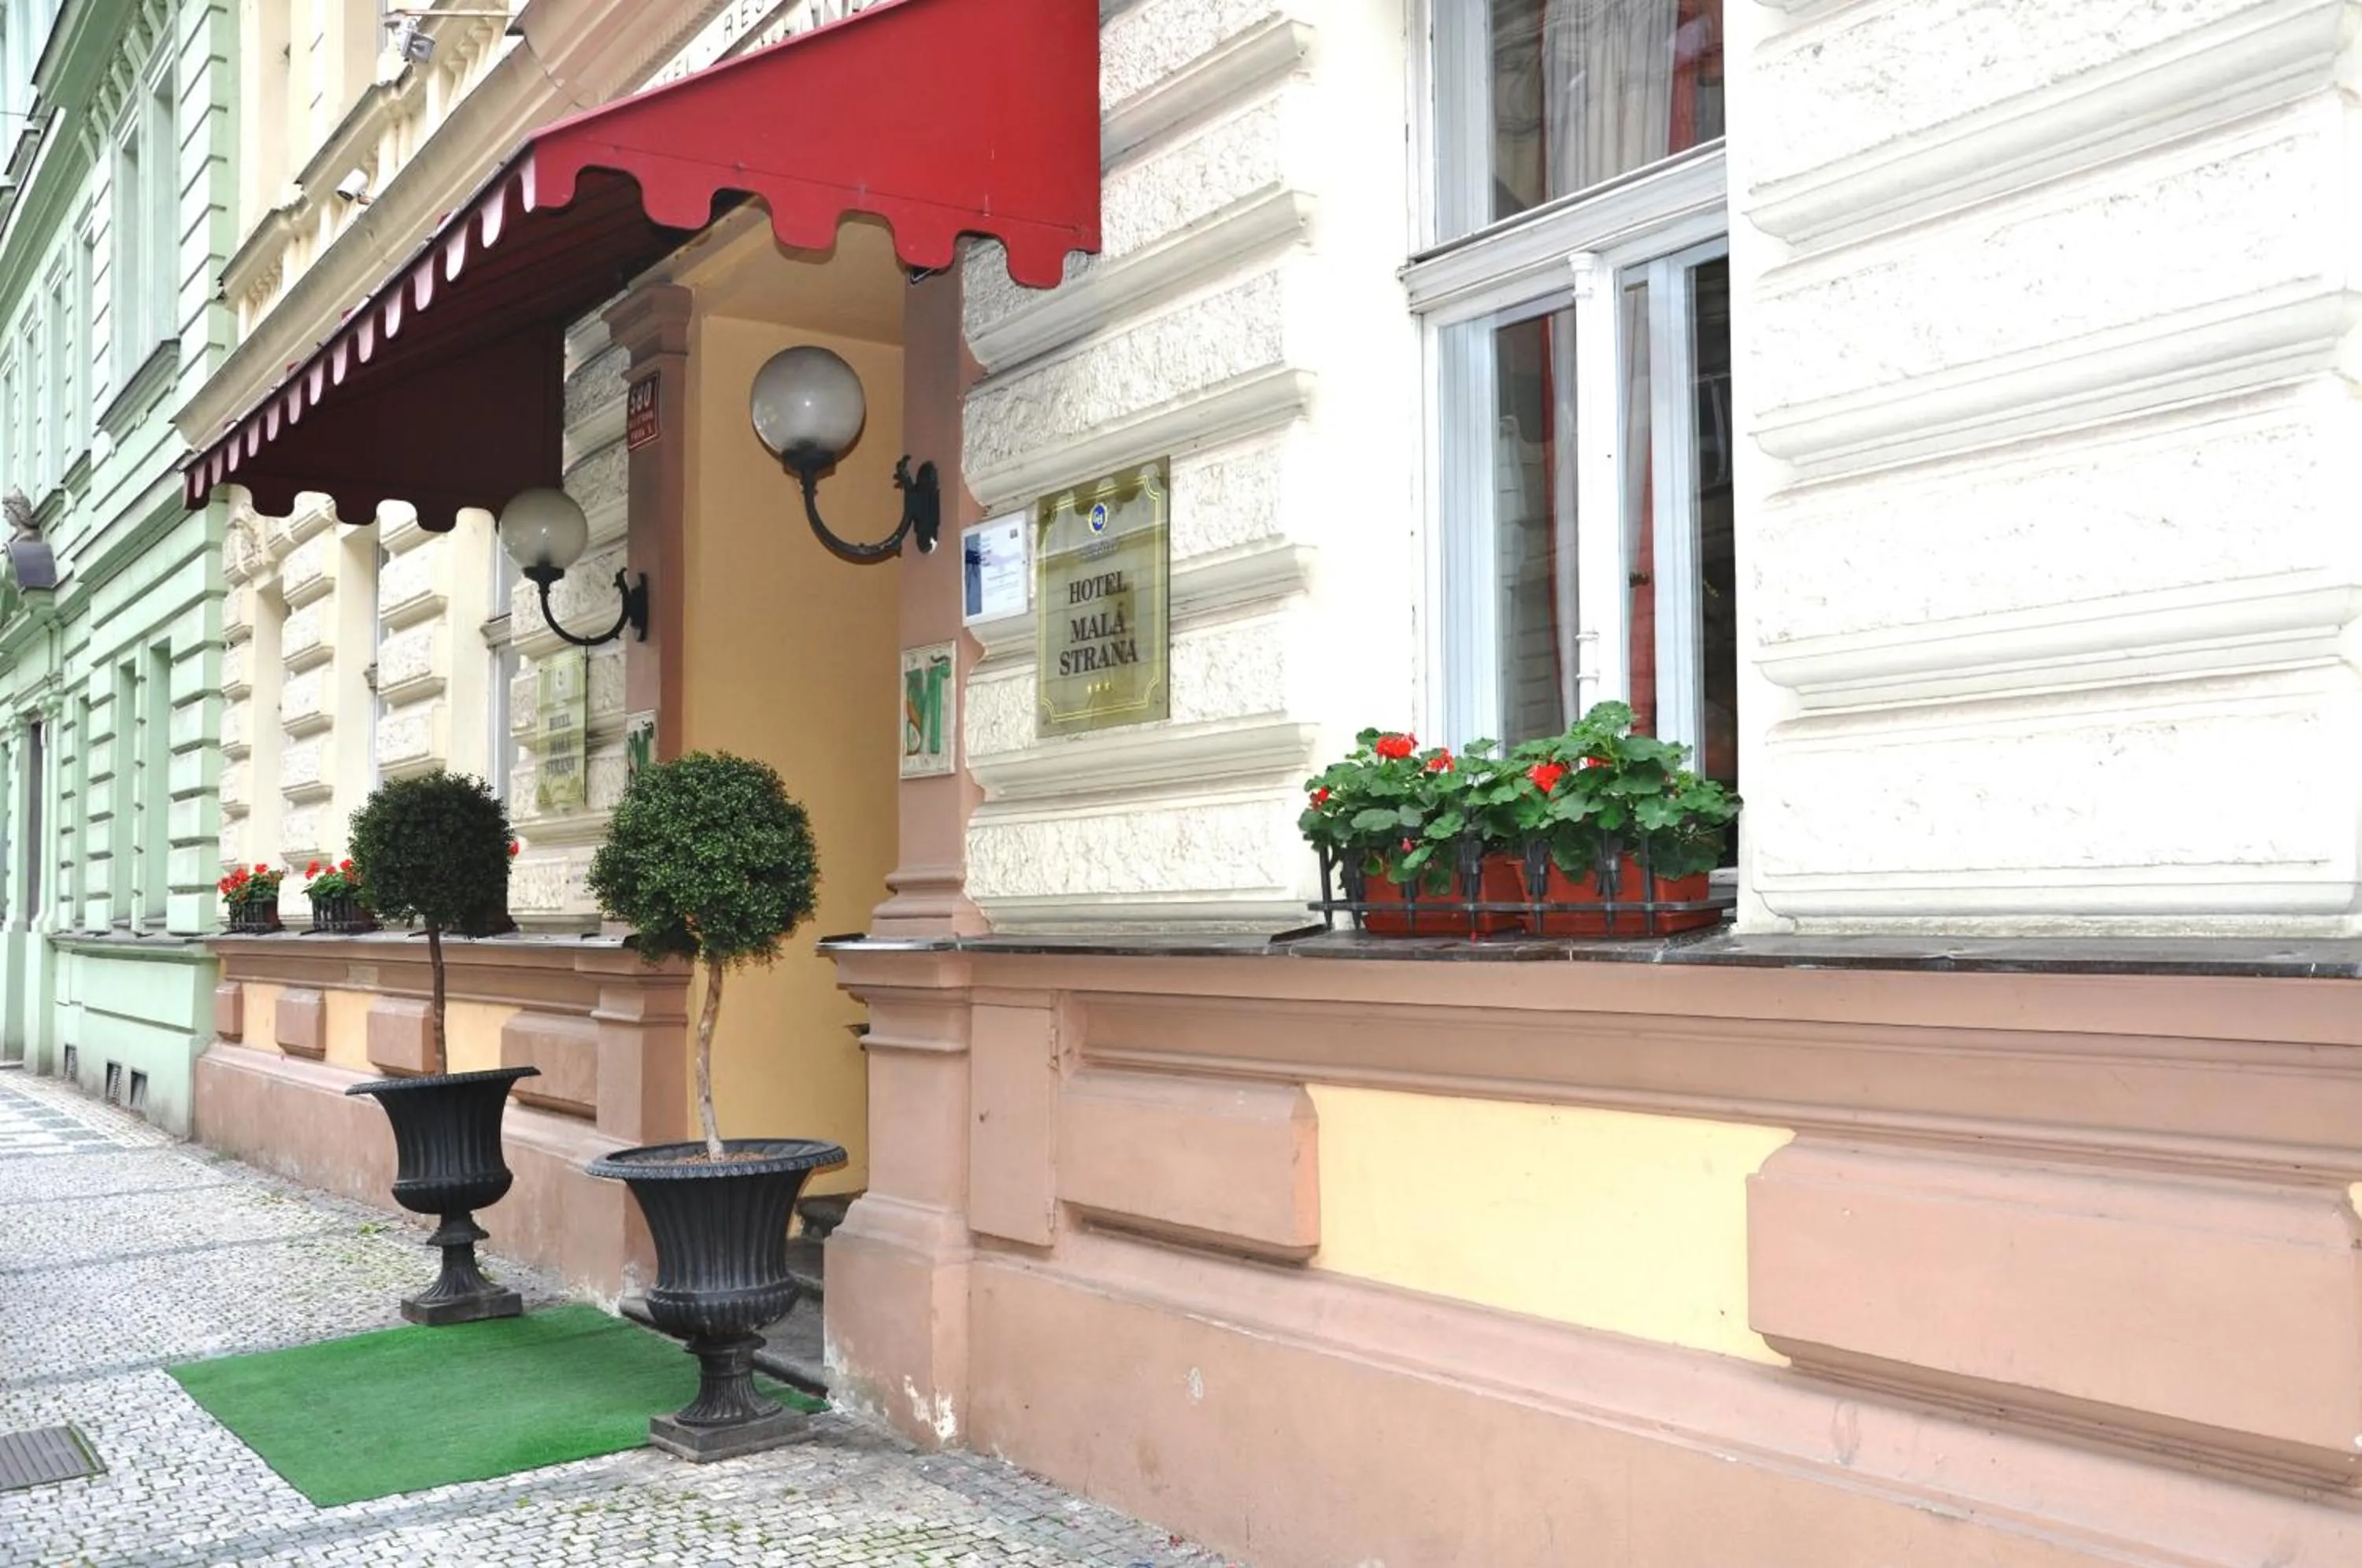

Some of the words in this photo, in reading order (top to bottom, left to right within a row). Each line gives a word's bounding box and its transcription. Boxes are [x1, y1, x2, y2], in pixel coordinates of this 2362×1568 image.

[1069, 571, 1127, 605] HOTEL
[1070, 601, 1126, 644] MALÁ
[1059, 638, 1138, 675] STRANA
